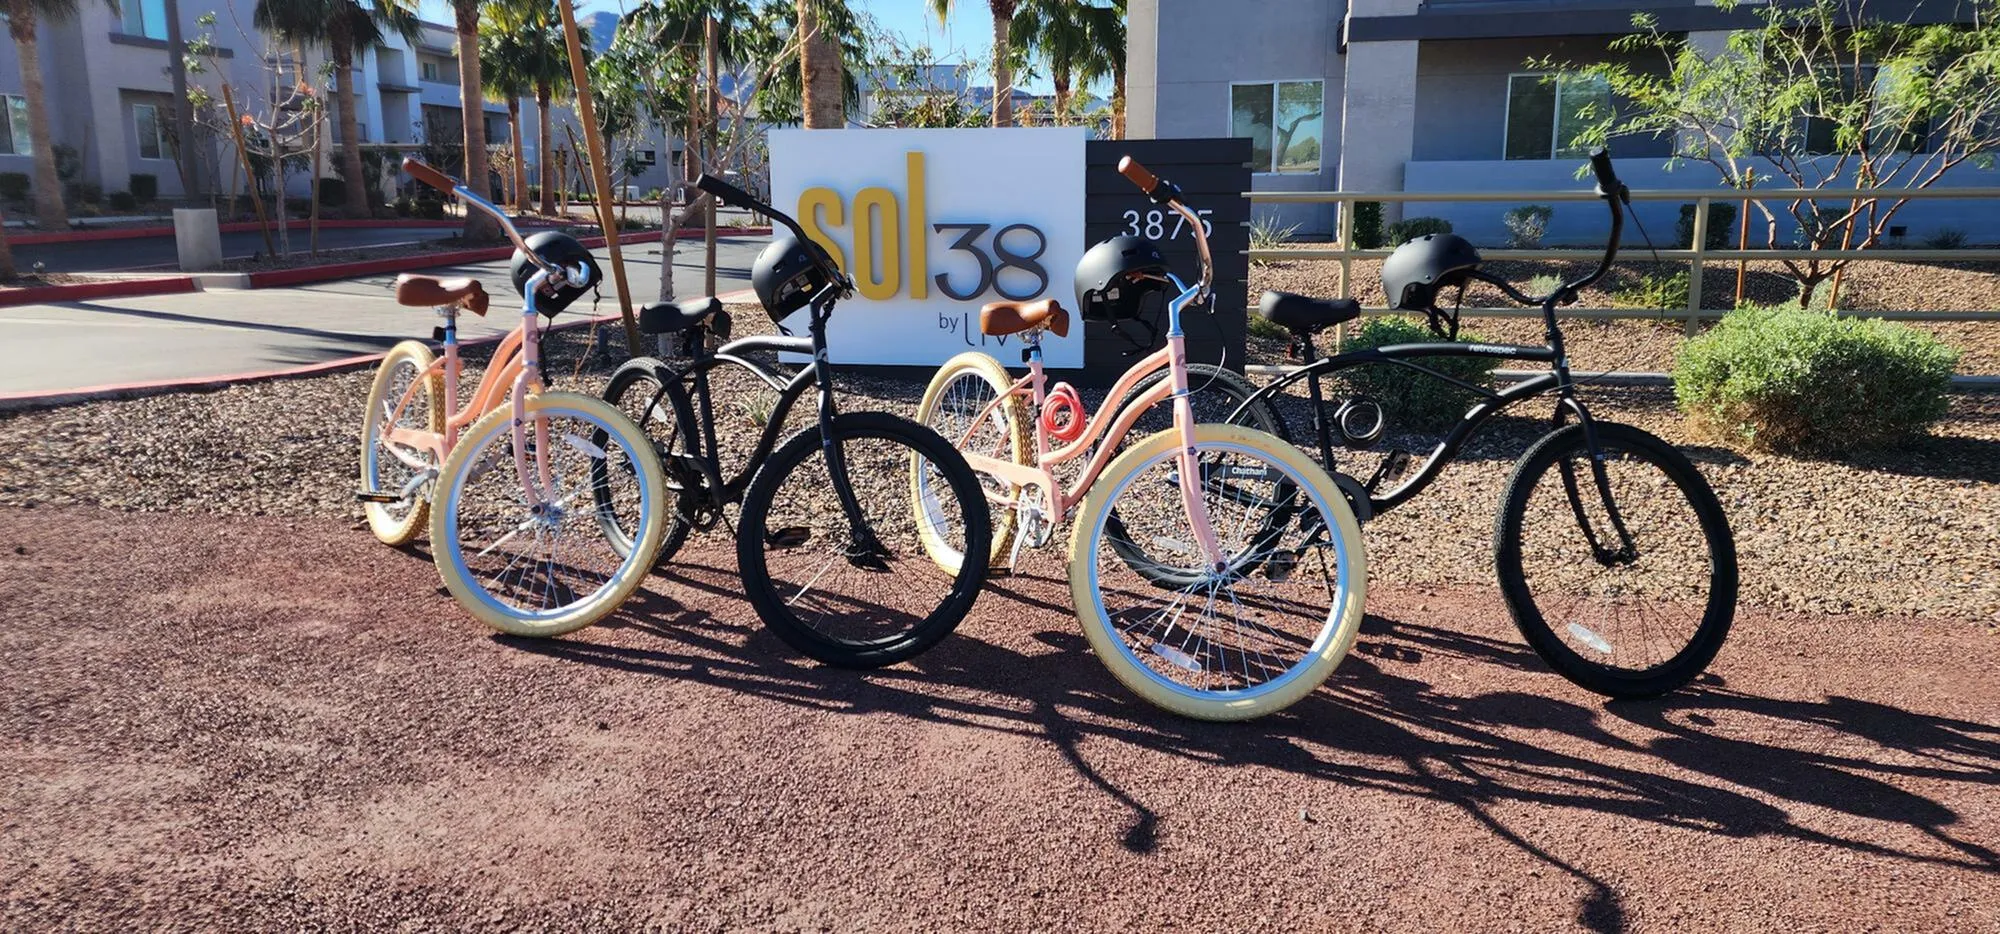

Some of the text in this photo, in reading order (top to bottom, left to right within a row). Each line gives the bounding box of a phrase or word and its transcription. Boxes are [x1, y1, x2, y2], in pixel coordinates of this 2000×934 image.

[1121, 209, 1213, 240] 3875
[939, 311, 959, 334] by
[1468, 344, 1517, 355] retrospec
[1231, 466, 1268, 476] Chatham
